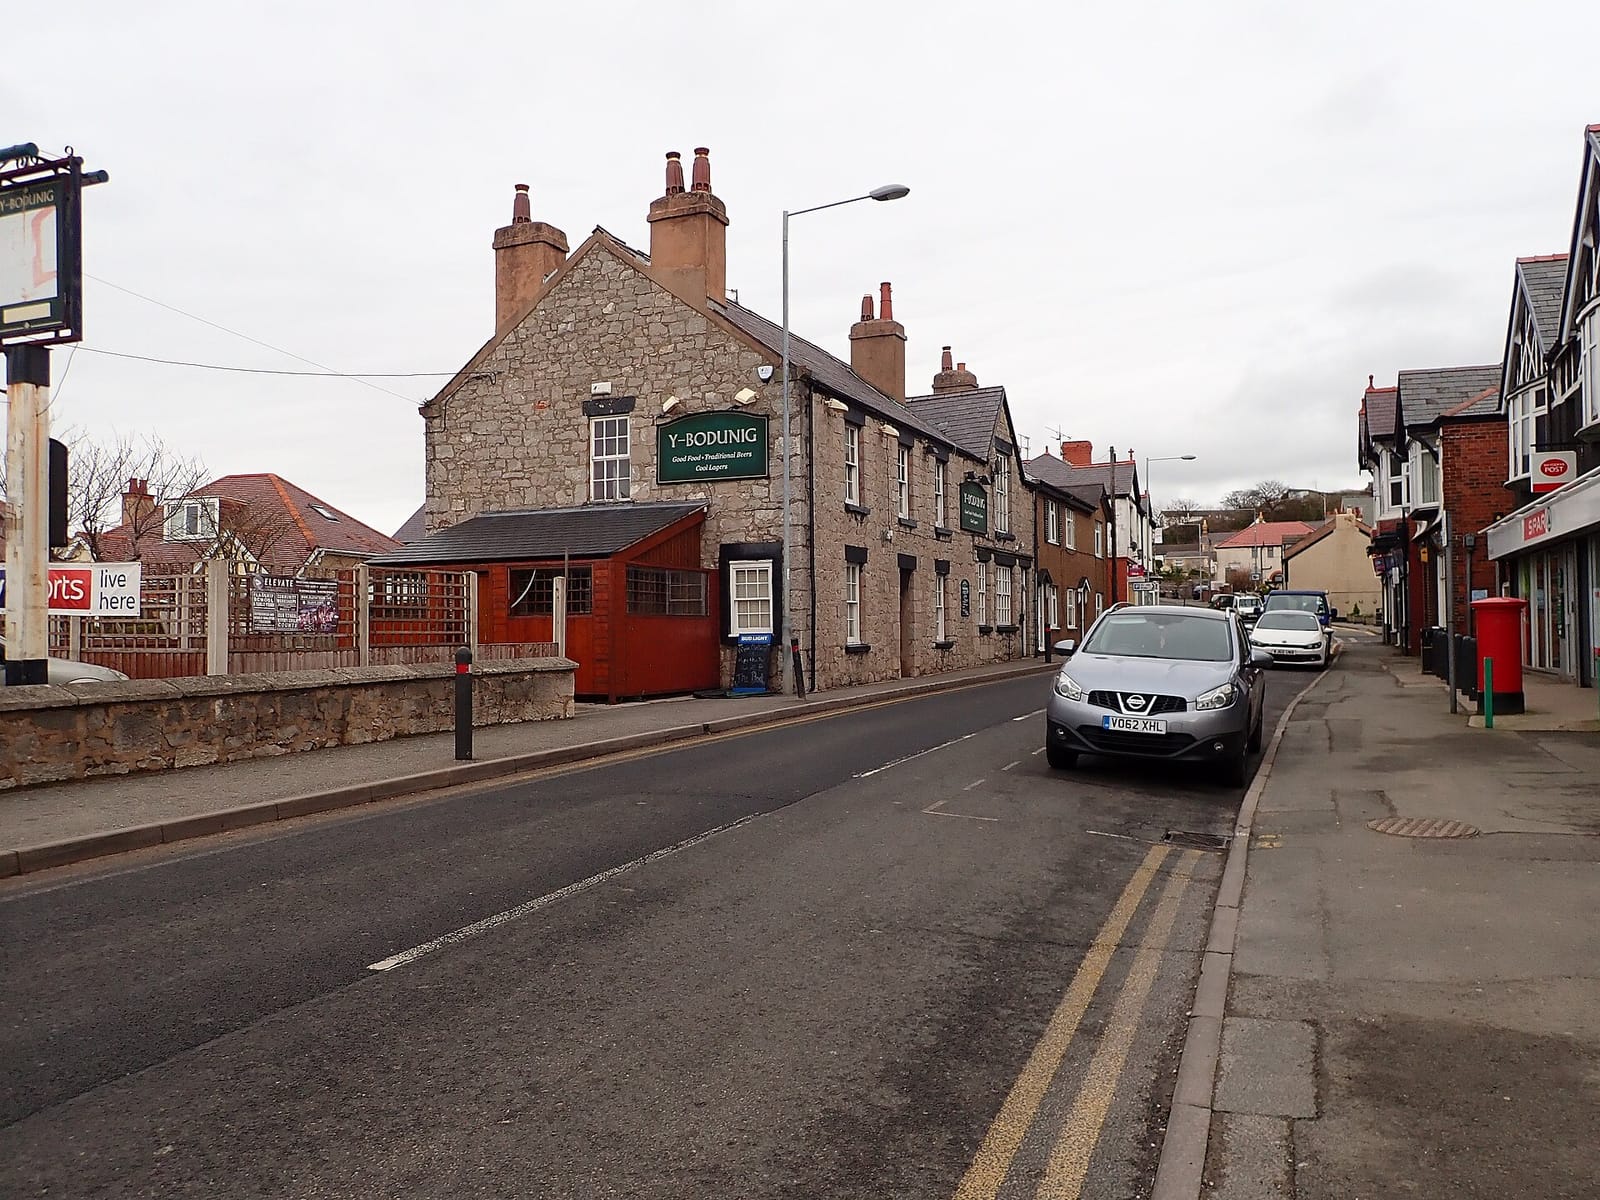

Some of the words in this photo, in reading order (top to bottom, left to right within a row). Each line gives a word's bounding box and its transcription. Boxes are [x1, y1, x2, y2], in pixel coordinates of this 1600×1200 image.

[668, 428, 757, 448] Y-BODUNIG
[672, 455, 686, 463] Good
[688, 454, 701, 462] Food
[704, 451, 736, 461] Traditional
[736, 451, 752, 459] Beers
[695, 464, 708, 472] Cool
[709, 464, 728, 472] Lagers
[1528, 513, 1546, 536] SPAR
[100, 569, 127, 588] live
[264, 577, 294, 588] ELEVATE
[99, 591, 136, 610] here
[1111, 717, 1139, 730] VO62
[1142, 721, 1163, 732] XHL
